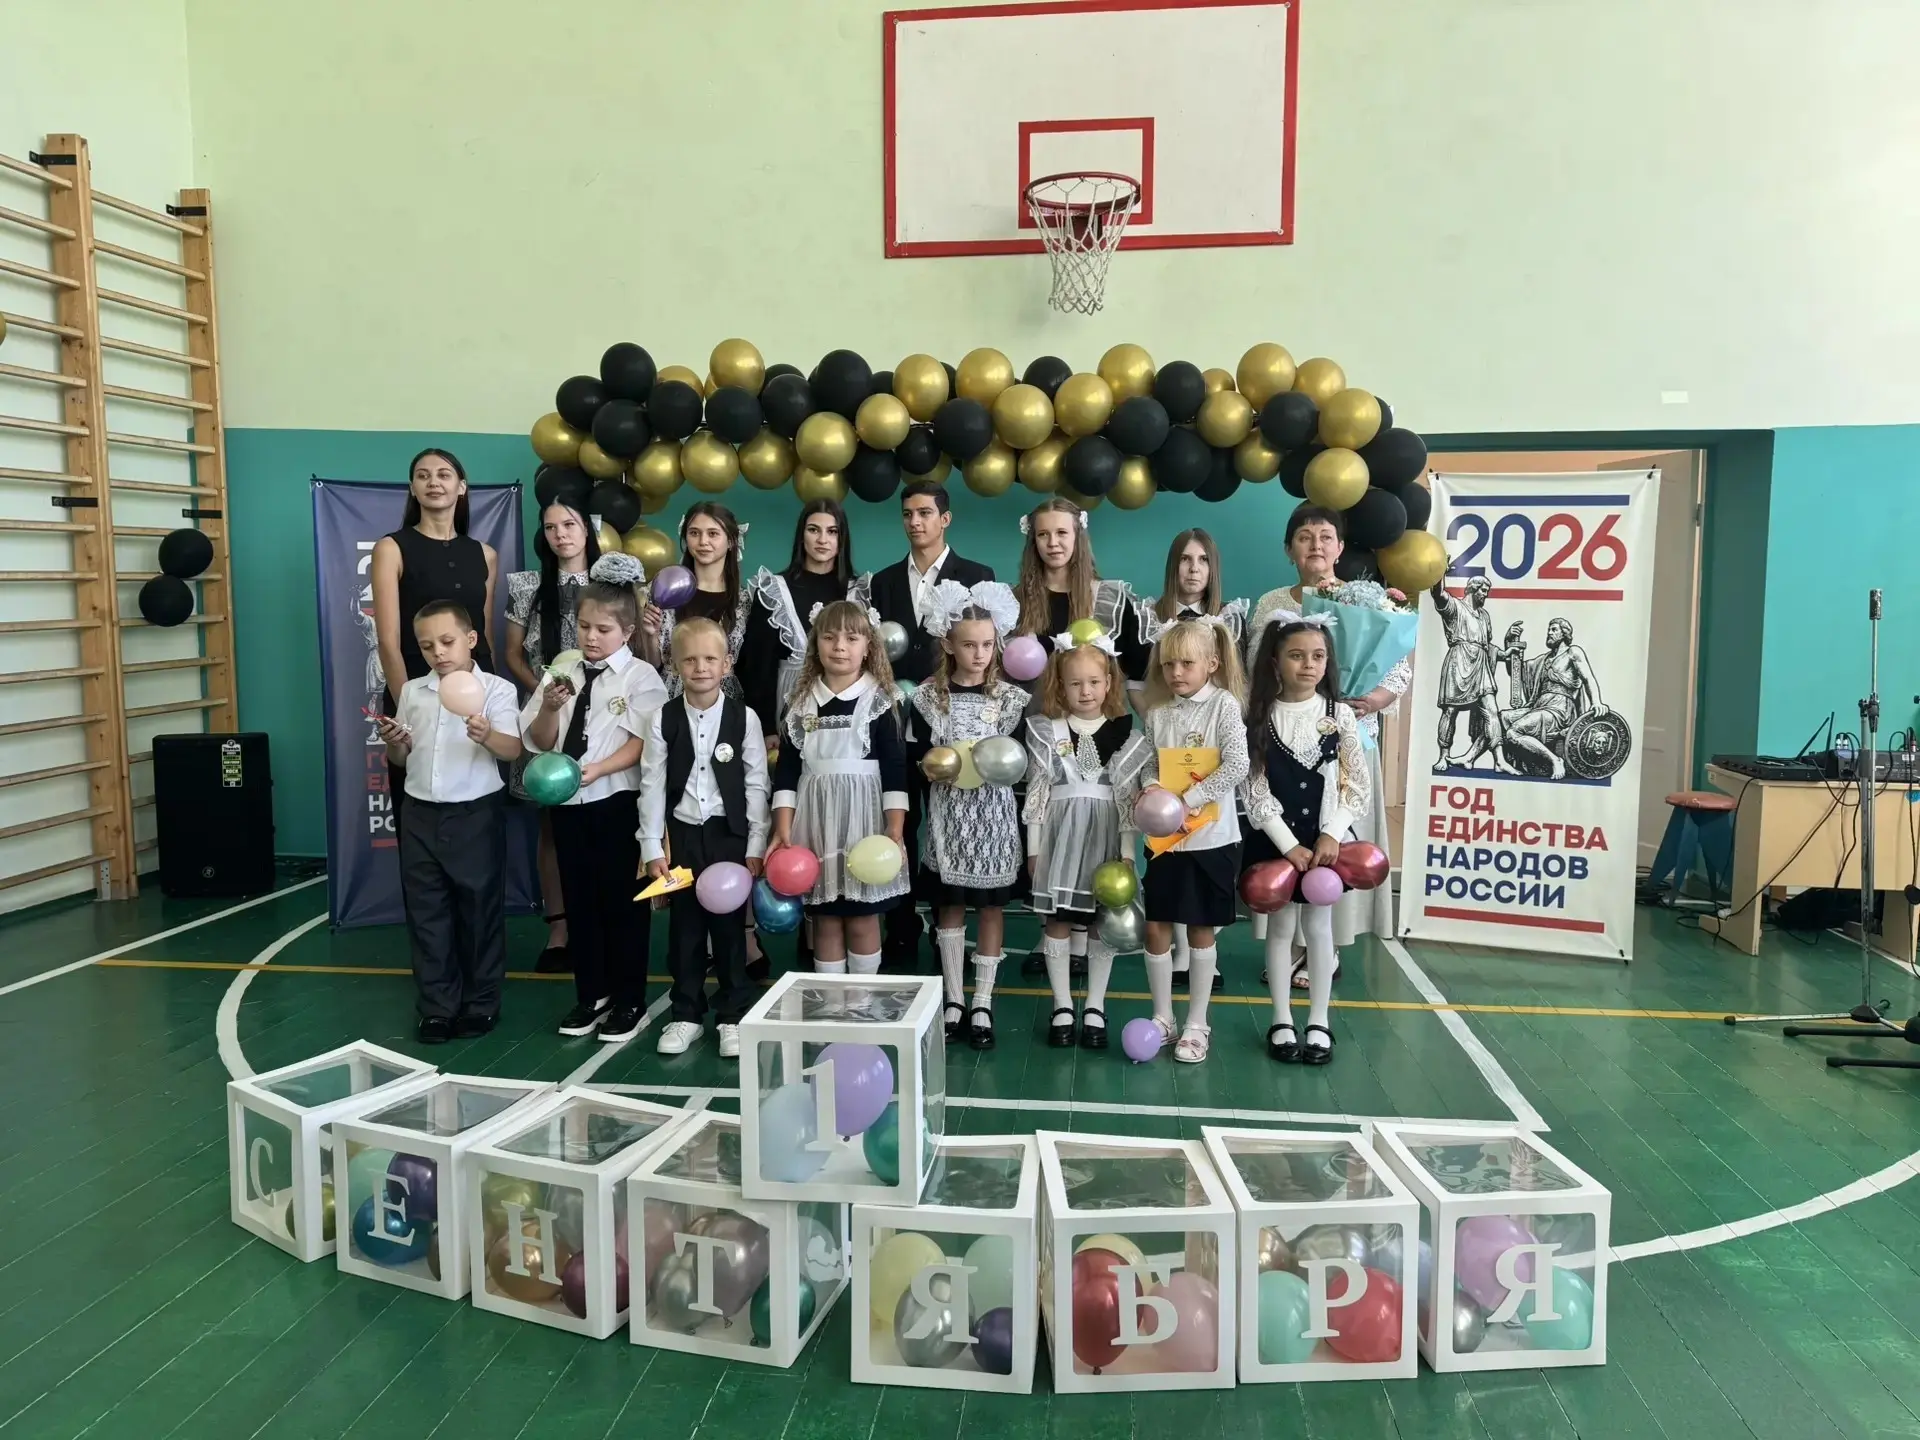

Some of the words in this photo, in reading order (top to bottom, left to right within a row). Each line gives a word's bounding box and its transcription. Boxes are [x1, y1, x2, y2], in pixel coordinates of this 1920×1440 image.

[1446, 514, 1627, 580] 2026
[1430, 786, 1495, 815] ГОД
[1428, 816, 1608, 851] ЕДИНСТВА
[1426, 845, 1589, 880] НАРОДОВ
[1425, 874, 1565, 908] РОССИИ
[802, 1059, 850, 1152] 1
